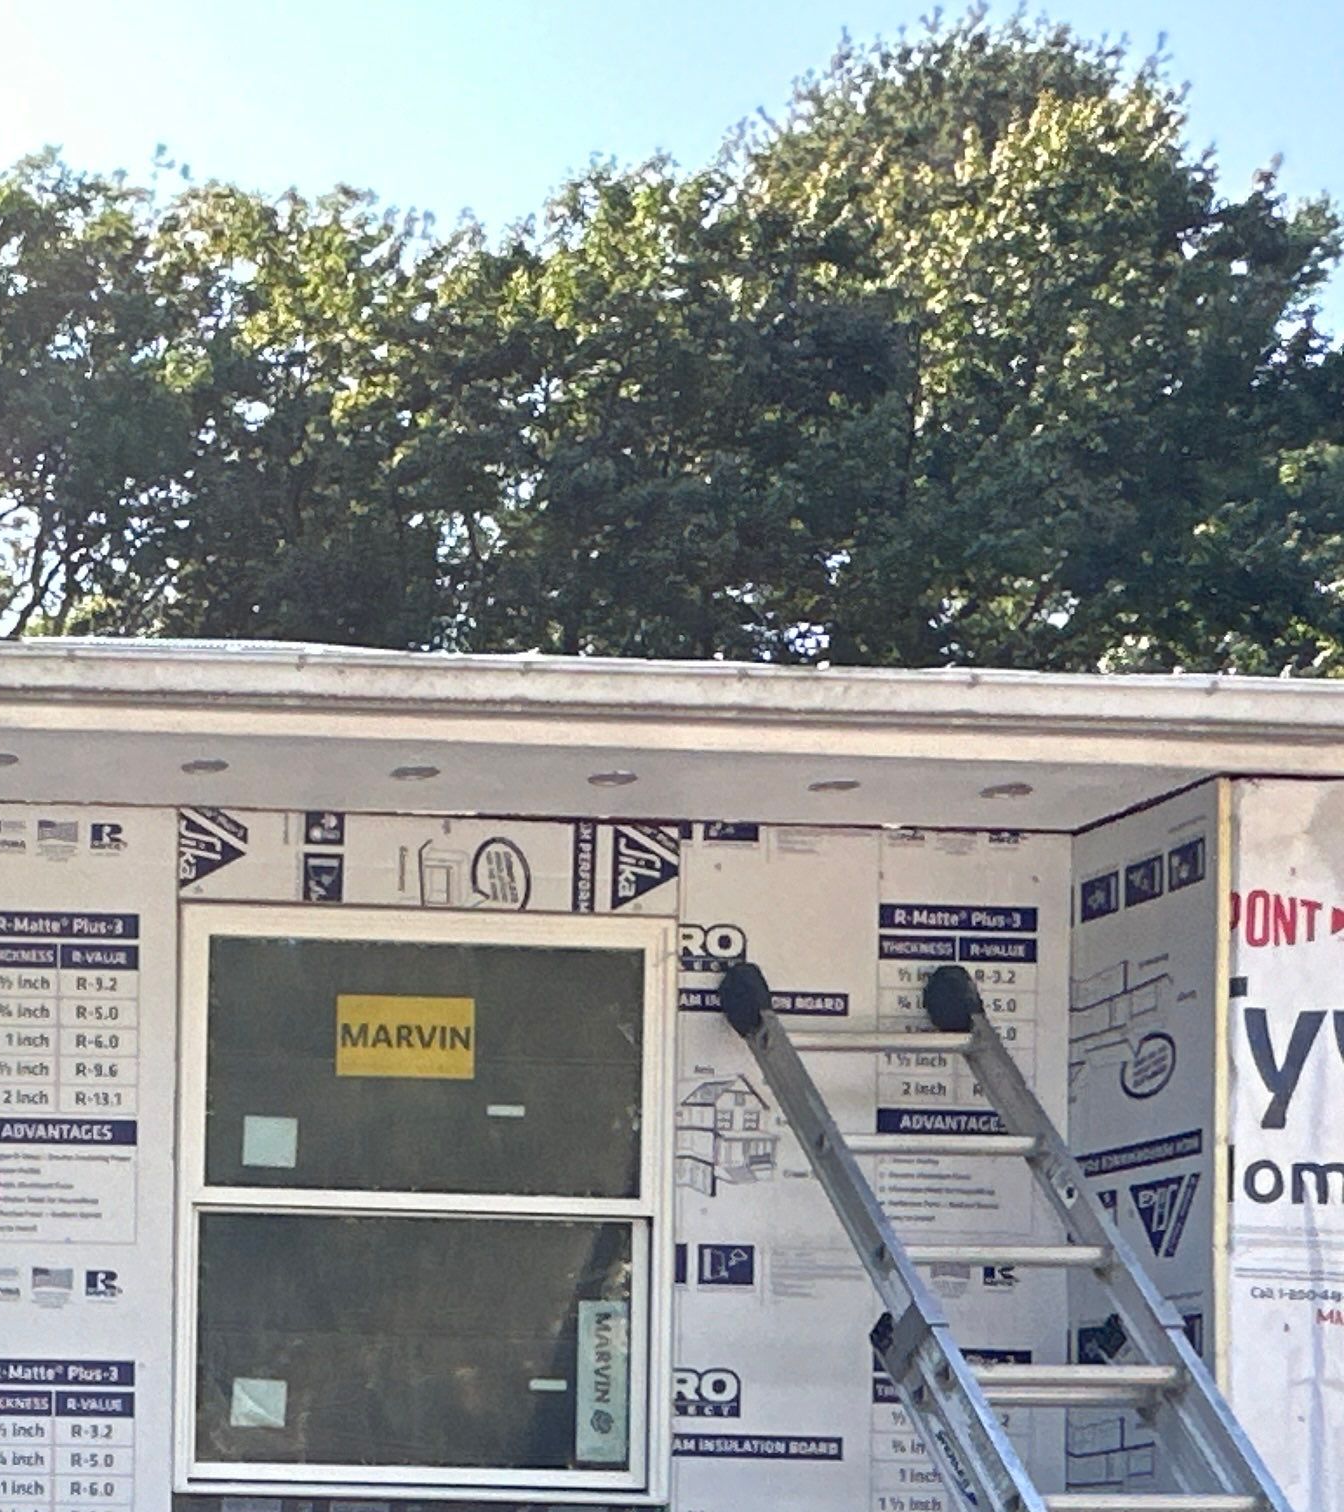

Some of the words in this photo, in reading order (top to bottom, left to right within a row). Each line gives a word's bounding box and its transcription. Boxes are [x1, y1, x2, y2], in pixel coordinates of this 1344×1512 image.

[180, 819, 222, 880] Sika
[618, 837, 662, 898] Sika
[341, 1023, 471, 1050] MARVIN
[1, 1123, 113, 1140] ADVANTAGES
[594, 1311, 612, 1404] MARVIN
